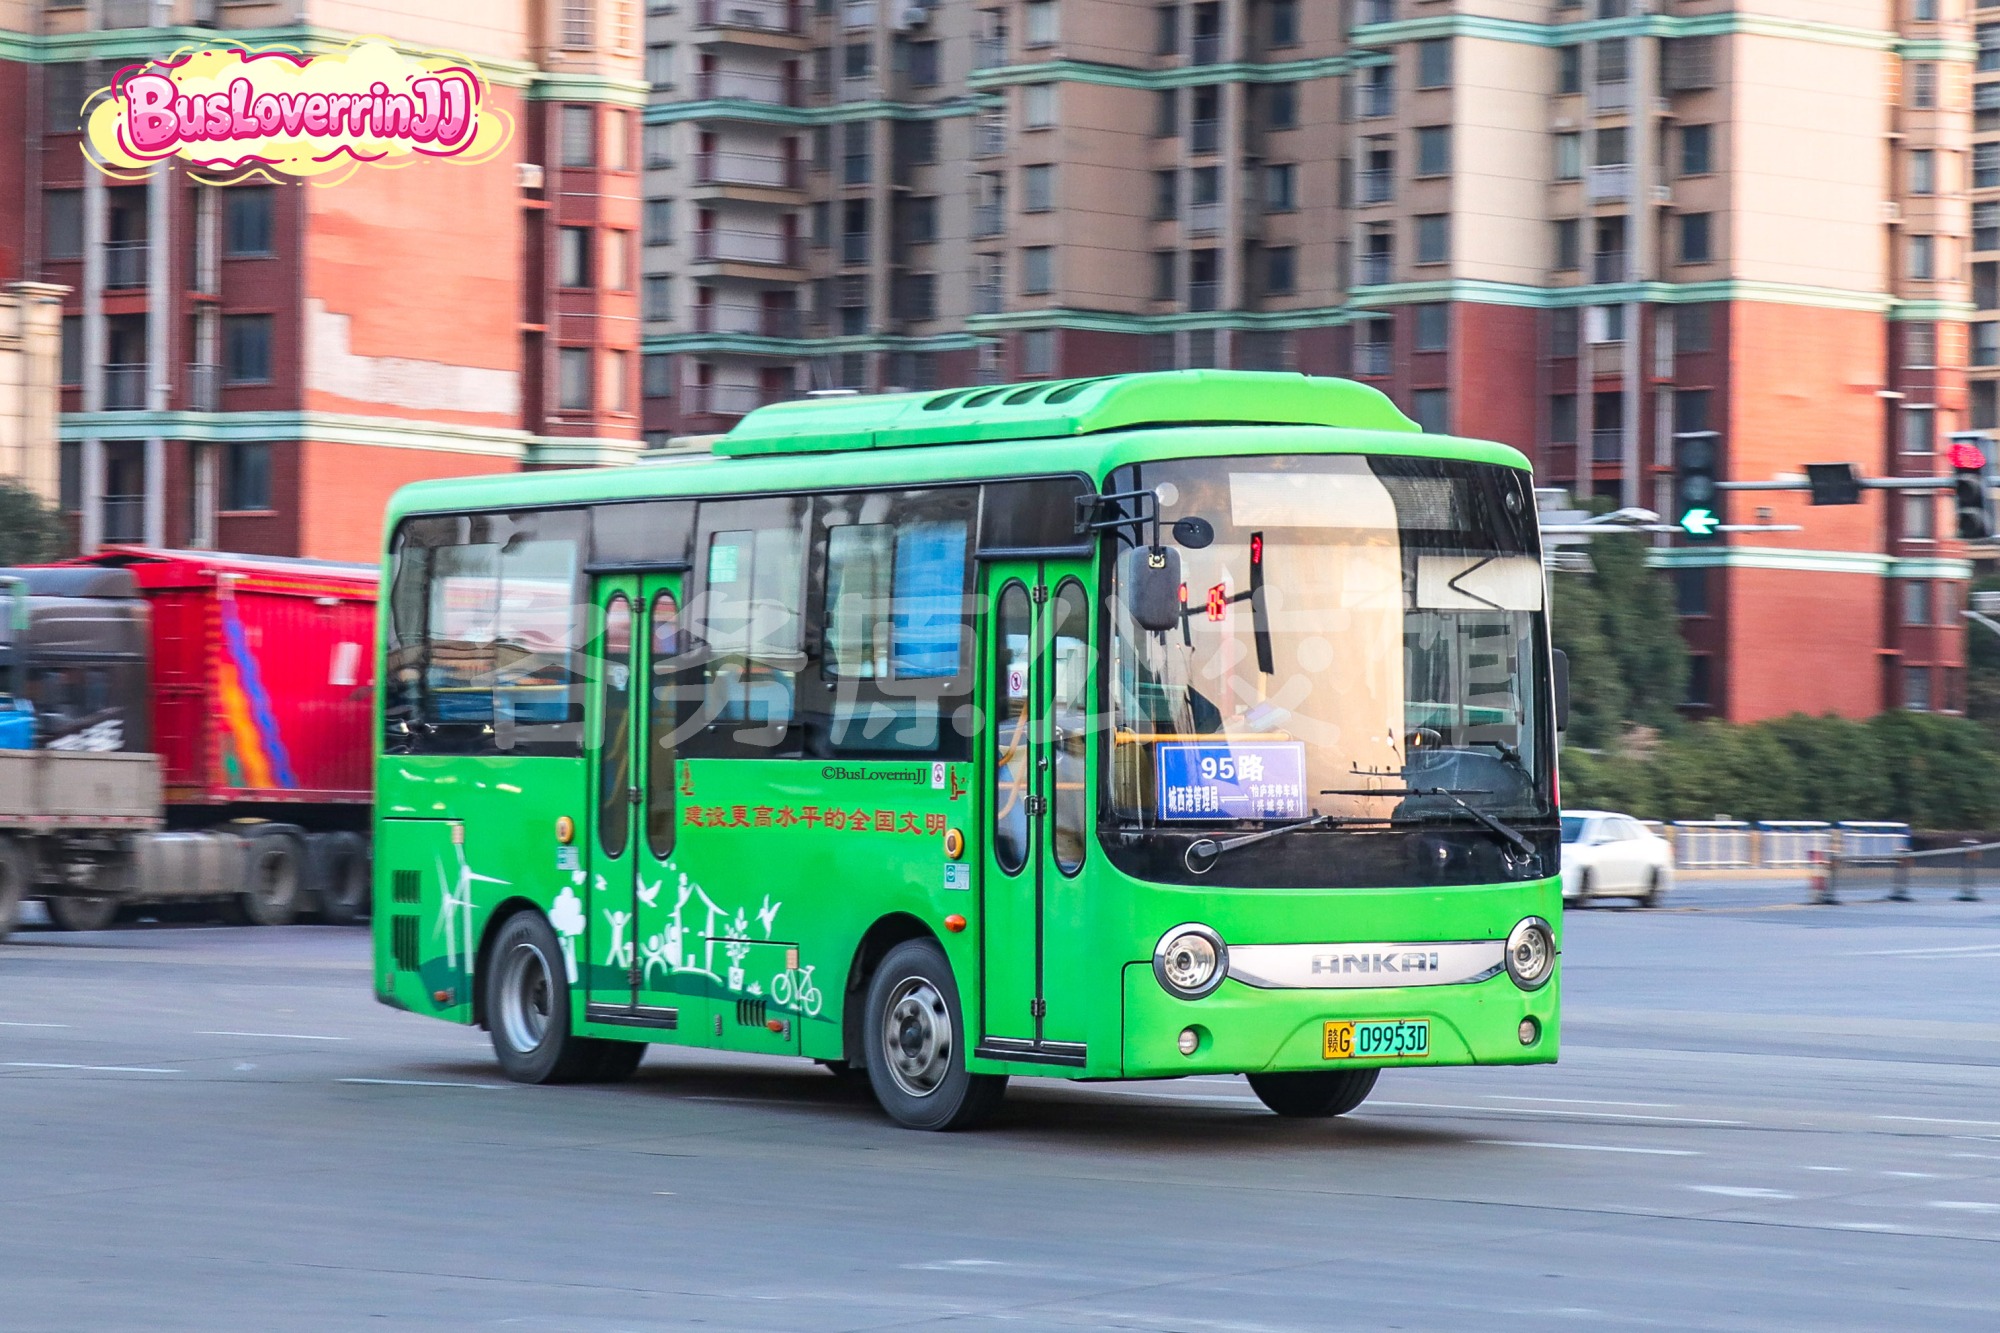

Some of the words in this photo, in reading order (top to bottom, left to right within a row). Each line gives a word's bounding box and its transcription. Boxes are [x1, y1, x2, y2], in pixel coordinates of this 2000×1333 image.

[1201, 754, 1265, 782] 95路
[682, 804, 948, 837] 建设更高水平的全国文明
[1311, 952, 1439, 974] ANKAI
